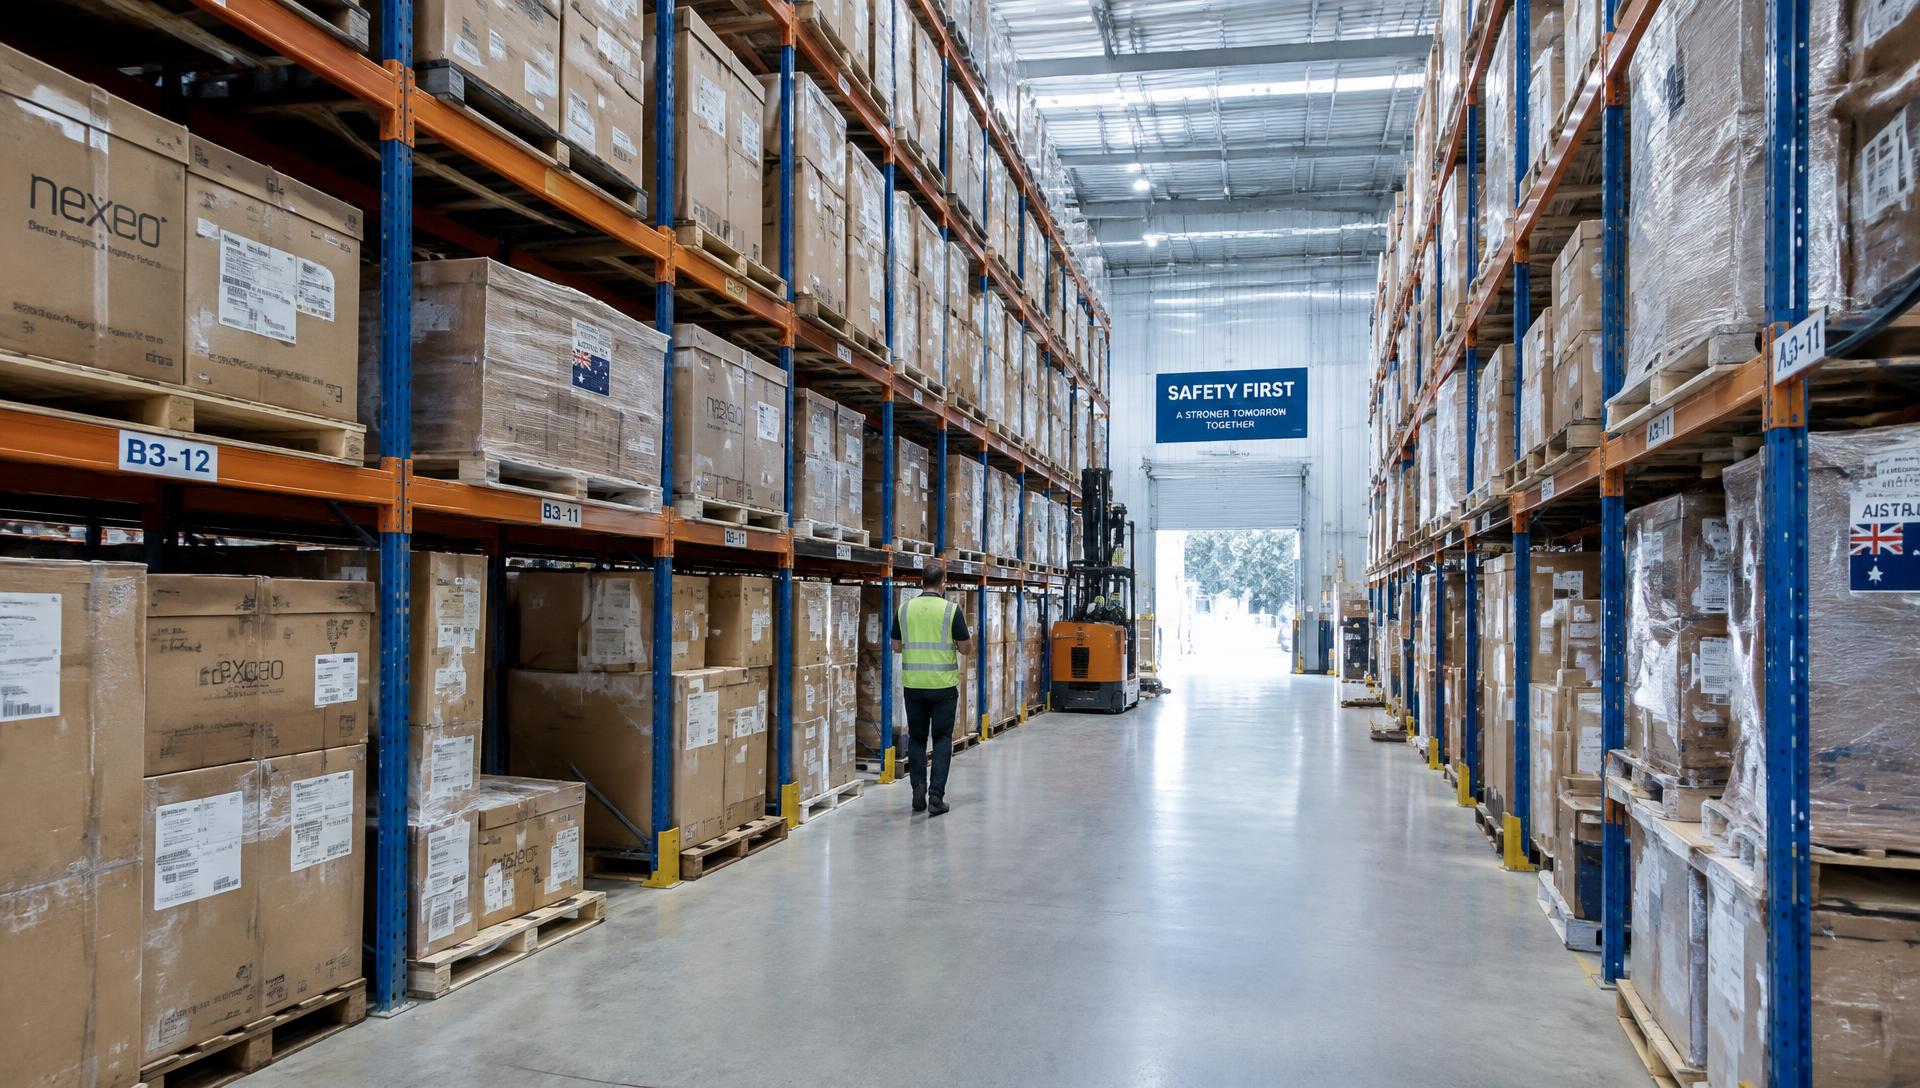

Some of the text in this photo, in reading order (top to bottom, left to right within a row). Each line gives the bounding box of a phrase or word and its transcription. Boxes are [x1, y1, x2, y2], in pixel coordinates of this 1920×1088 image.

[30, 173, 160, 248] nexeo
[1777, 320, 1820, 373] A3-11
[1168, 381, 1295, 401] SAFETY FIRST
[1176, 411, 1183, 419] A
[1232, 407, 1287, 417] TOMORROW
[1206, 420, 1255, 430] TOGETHER
[127, 438, 210, 473] B3-12
[543, 502, 578, 523] B3-11
